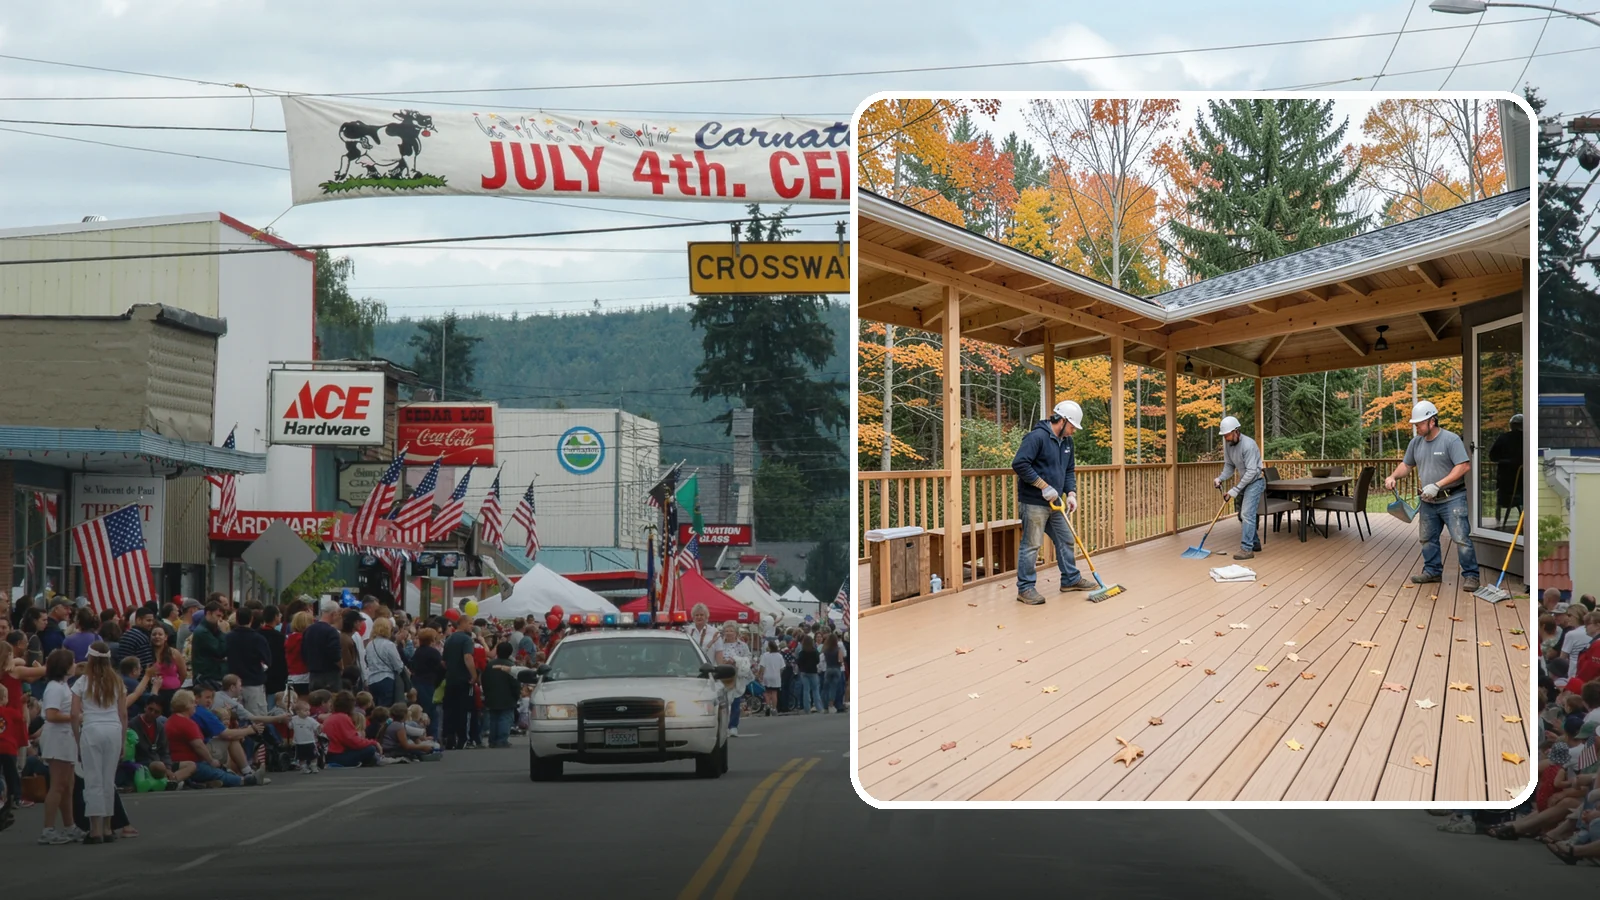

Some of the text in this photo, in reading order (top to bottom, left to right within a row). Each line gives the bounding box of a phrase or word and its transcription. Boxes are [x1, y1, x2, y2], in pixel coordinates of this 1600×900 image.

[481, 140, 605, 193] JULY
[632, 150, 746, 198] 4th.
[697, 254, 850, 280] CROSSWA
[283, 380, 373, 420] ACE
[406, 409, 485, 422] CEDAR LOG
[283, 421, 371, 437] Hardware
[416, 428, 477, 447] Coca-Cola
[83, 485, 155, 495] St. Vincent de Paul
[212, 516, 330, 536] HARDARE
[688, 526, 741, 535] CRNATION
[699, 535, 730, 543] GLASS
